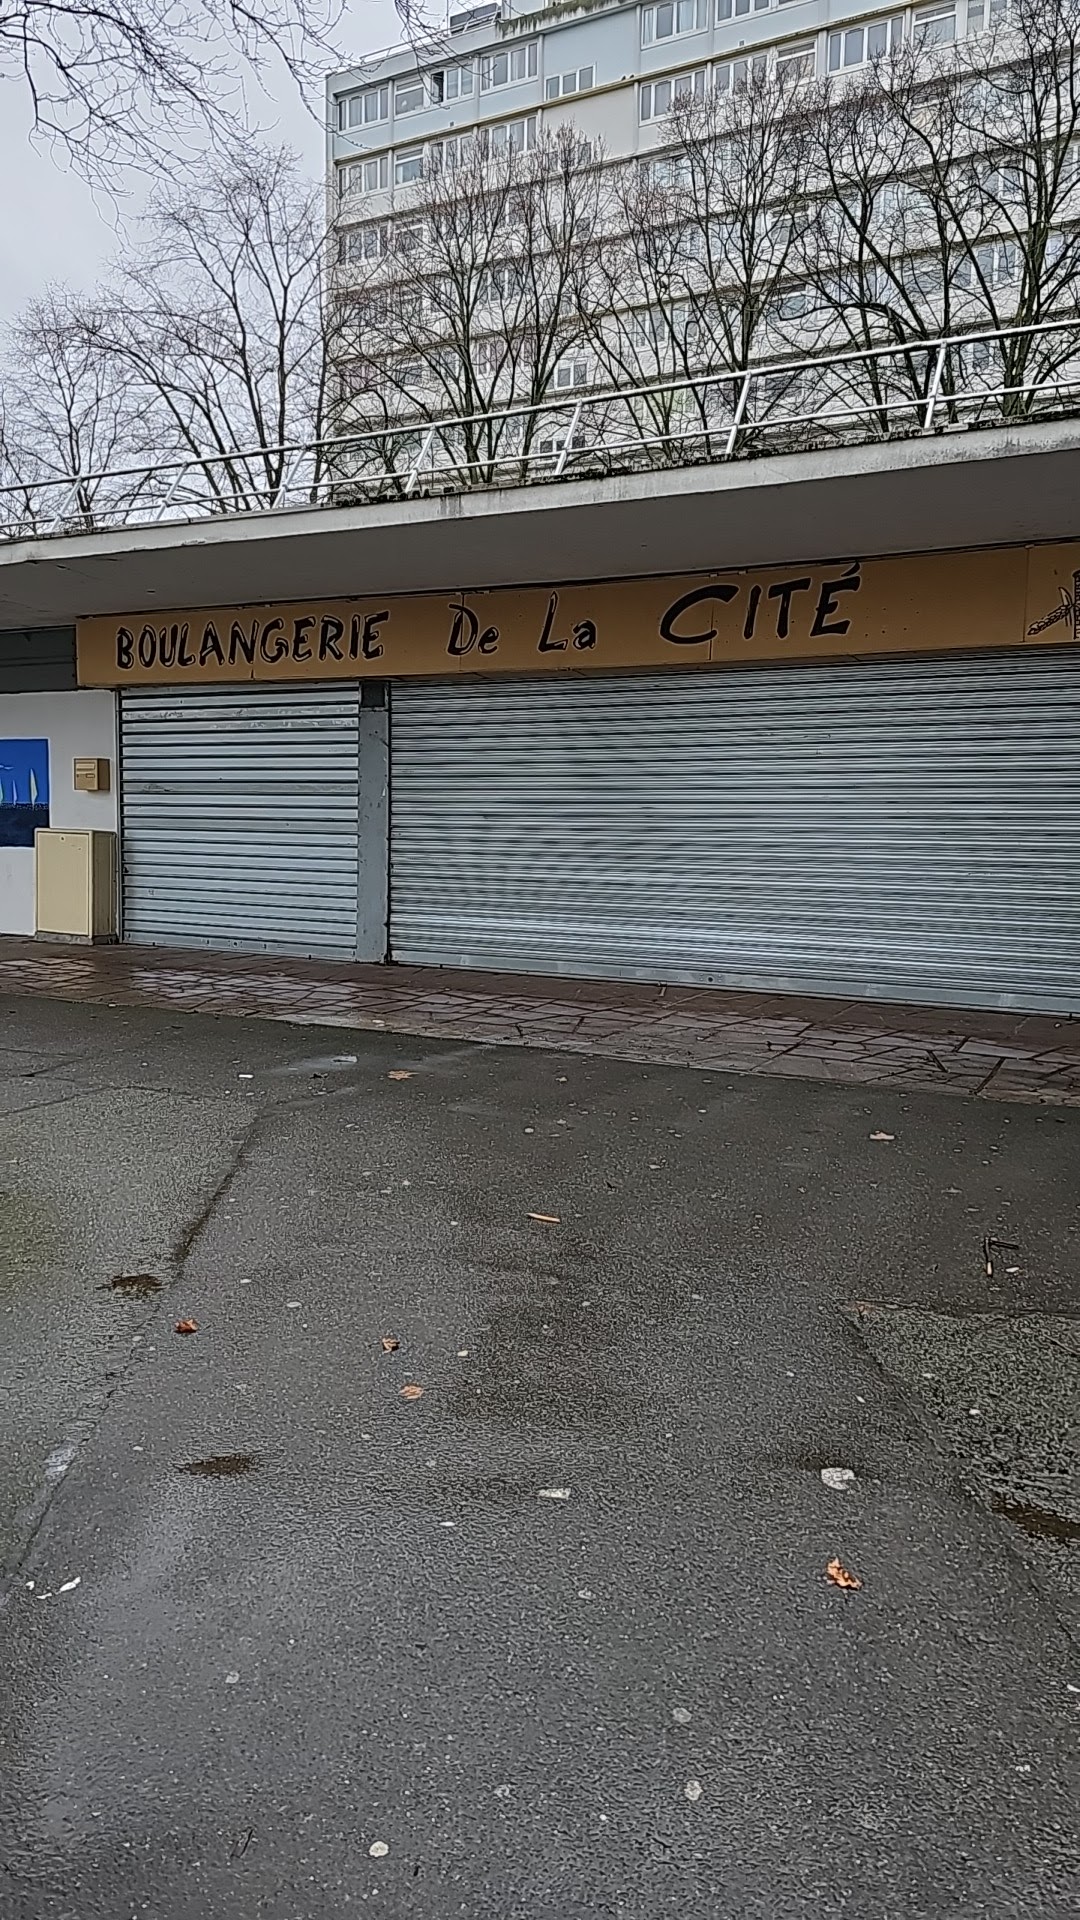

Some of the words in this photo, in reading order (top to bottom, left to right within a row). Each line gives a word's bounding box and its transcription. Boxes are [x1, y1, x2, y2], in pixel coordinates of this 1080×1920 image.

[116, 611, 388, 669] BOULANGERIE
[449, 603, 499, 656] De
[537, 591, 596, 654] La
[660, 562, 861, 644] CITÉ
